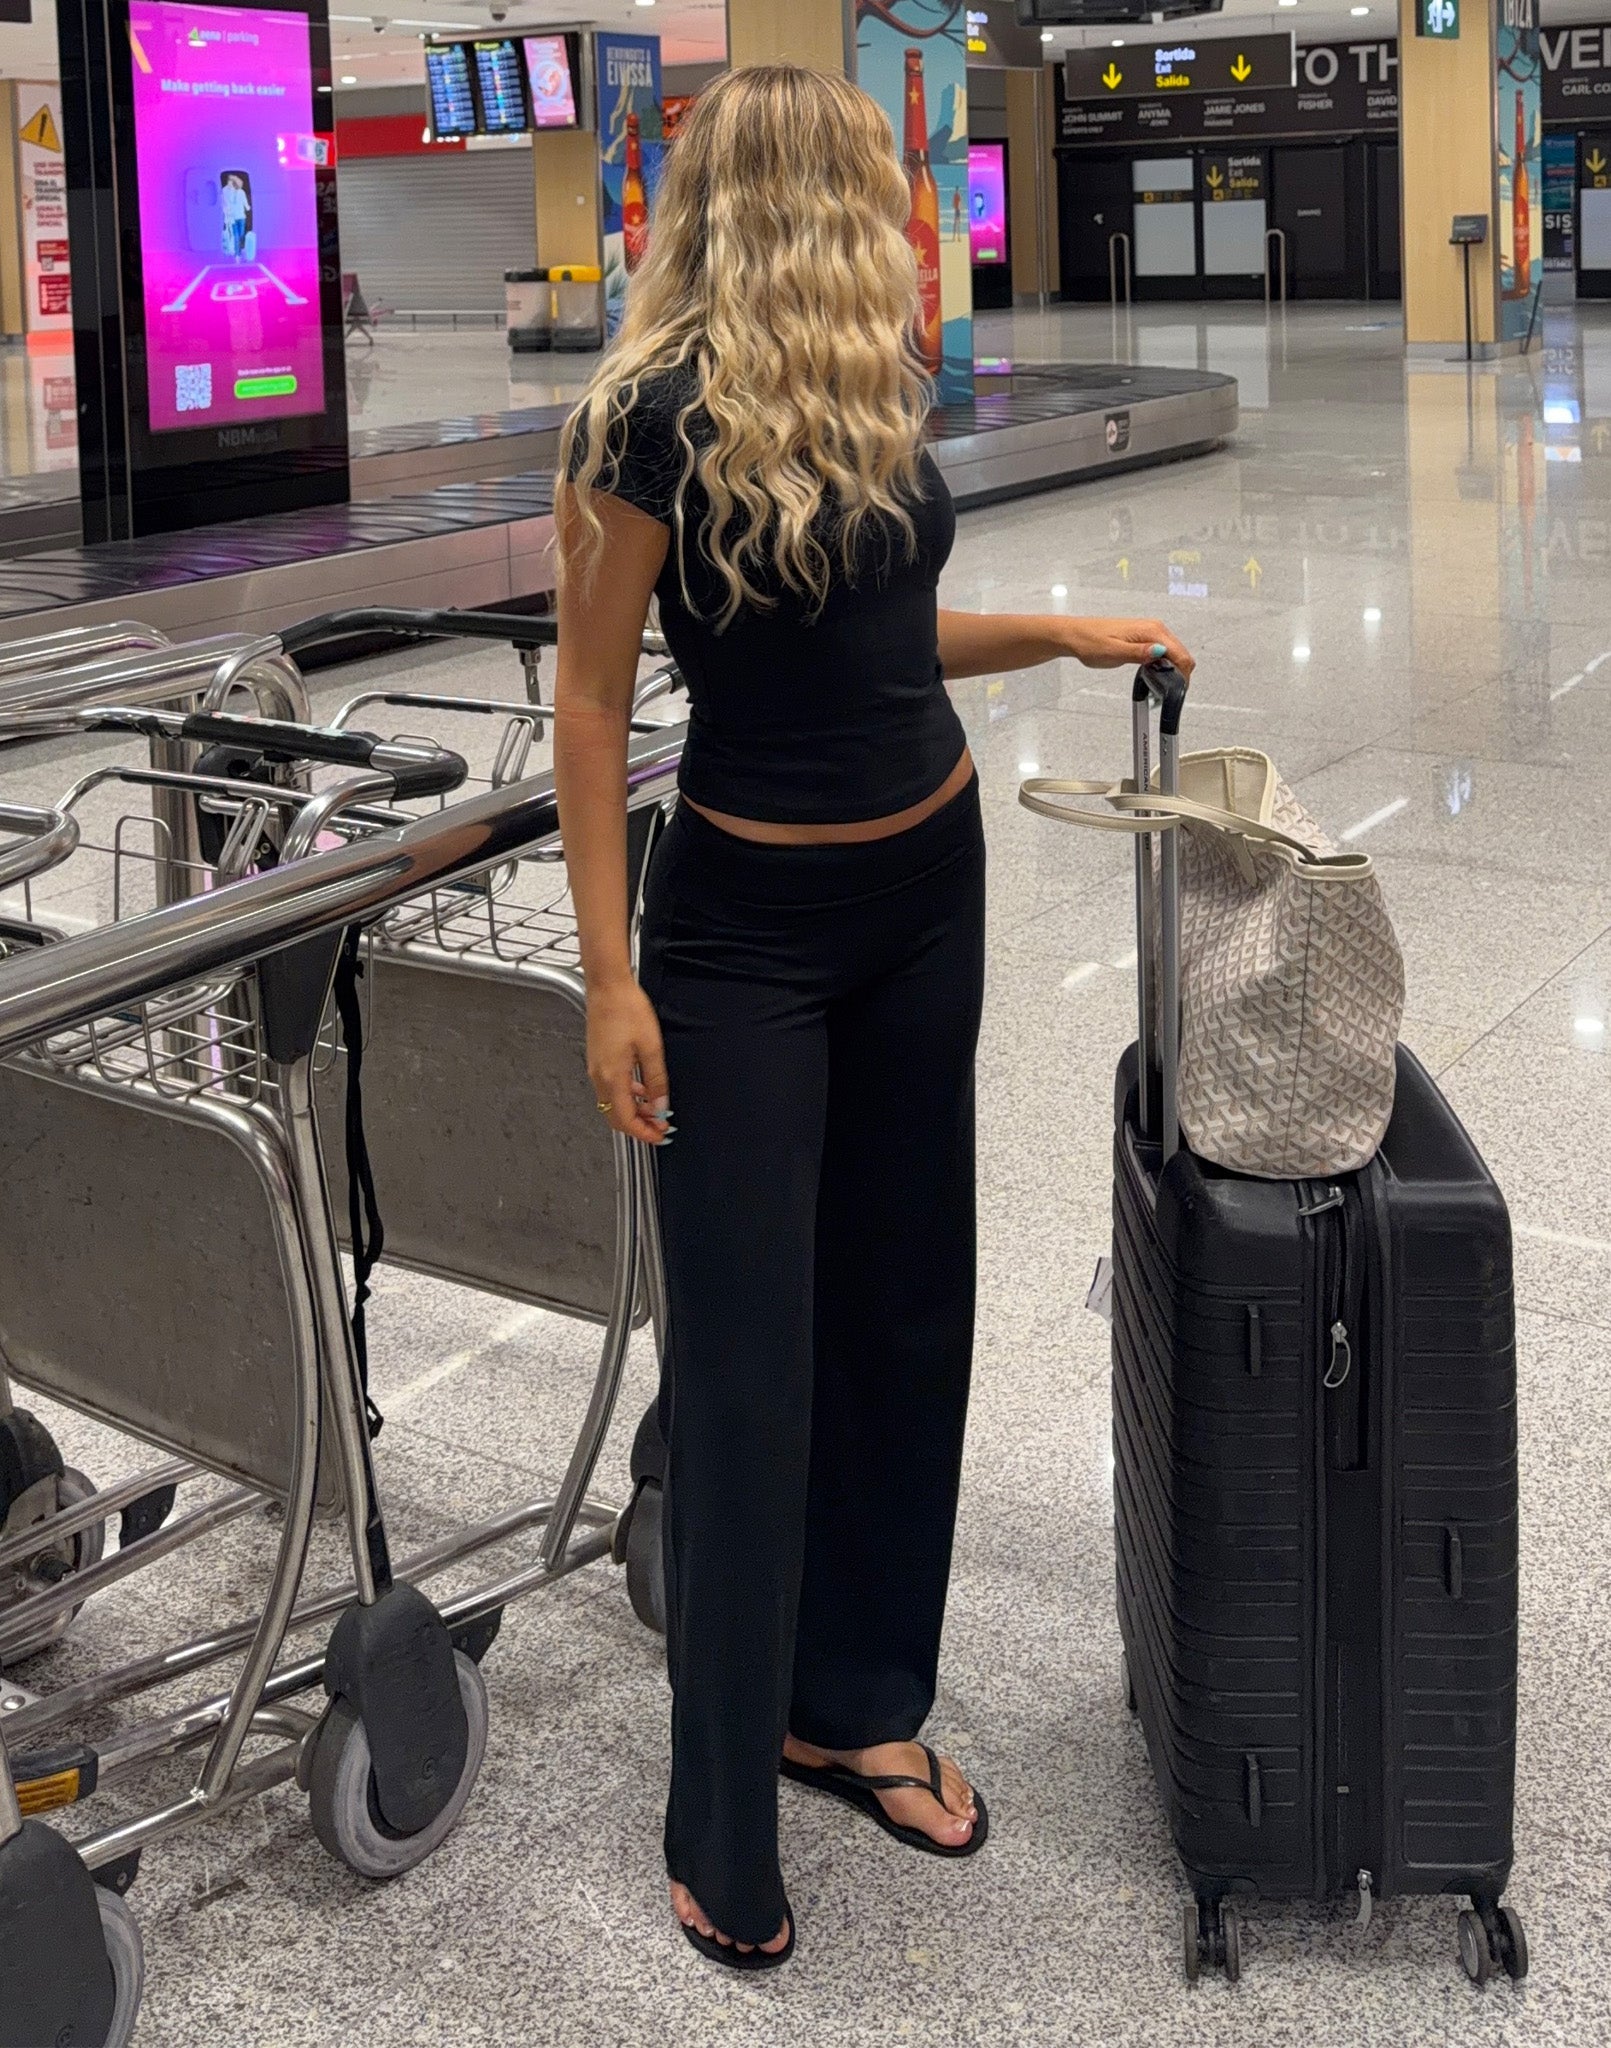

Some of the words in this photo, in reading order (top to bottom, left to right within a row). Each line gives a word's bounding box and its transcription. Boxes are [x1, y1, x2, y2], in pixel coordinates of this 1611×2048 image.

[1155, 47, 1196, 62] Sortida
[161, 78, 190, 92] Make
[191, 80, 230, 97] getting
[231, 81, 255, 95] back
[256, 84, 286, 97] easier
[1155, 74, 1190, 88] Salida
[1562, 84, 1593, 97] CARL
[1297, 98, 1334, 111] FISHER
[1366, 94, 1398, 107] DAVID
[1138, 108, 1172, 119] ANYMA
[1203, 104, 1233, 116] JAMIE
[1233, 102, 1266, 114] JONES
[1062, 113, 1087, 124] JOHN
[1088, 110, 1124, 122] SUMMIT
[1227, 156, 1262, 167] Sortida
[1229, 177, 1259, 189] Salida
